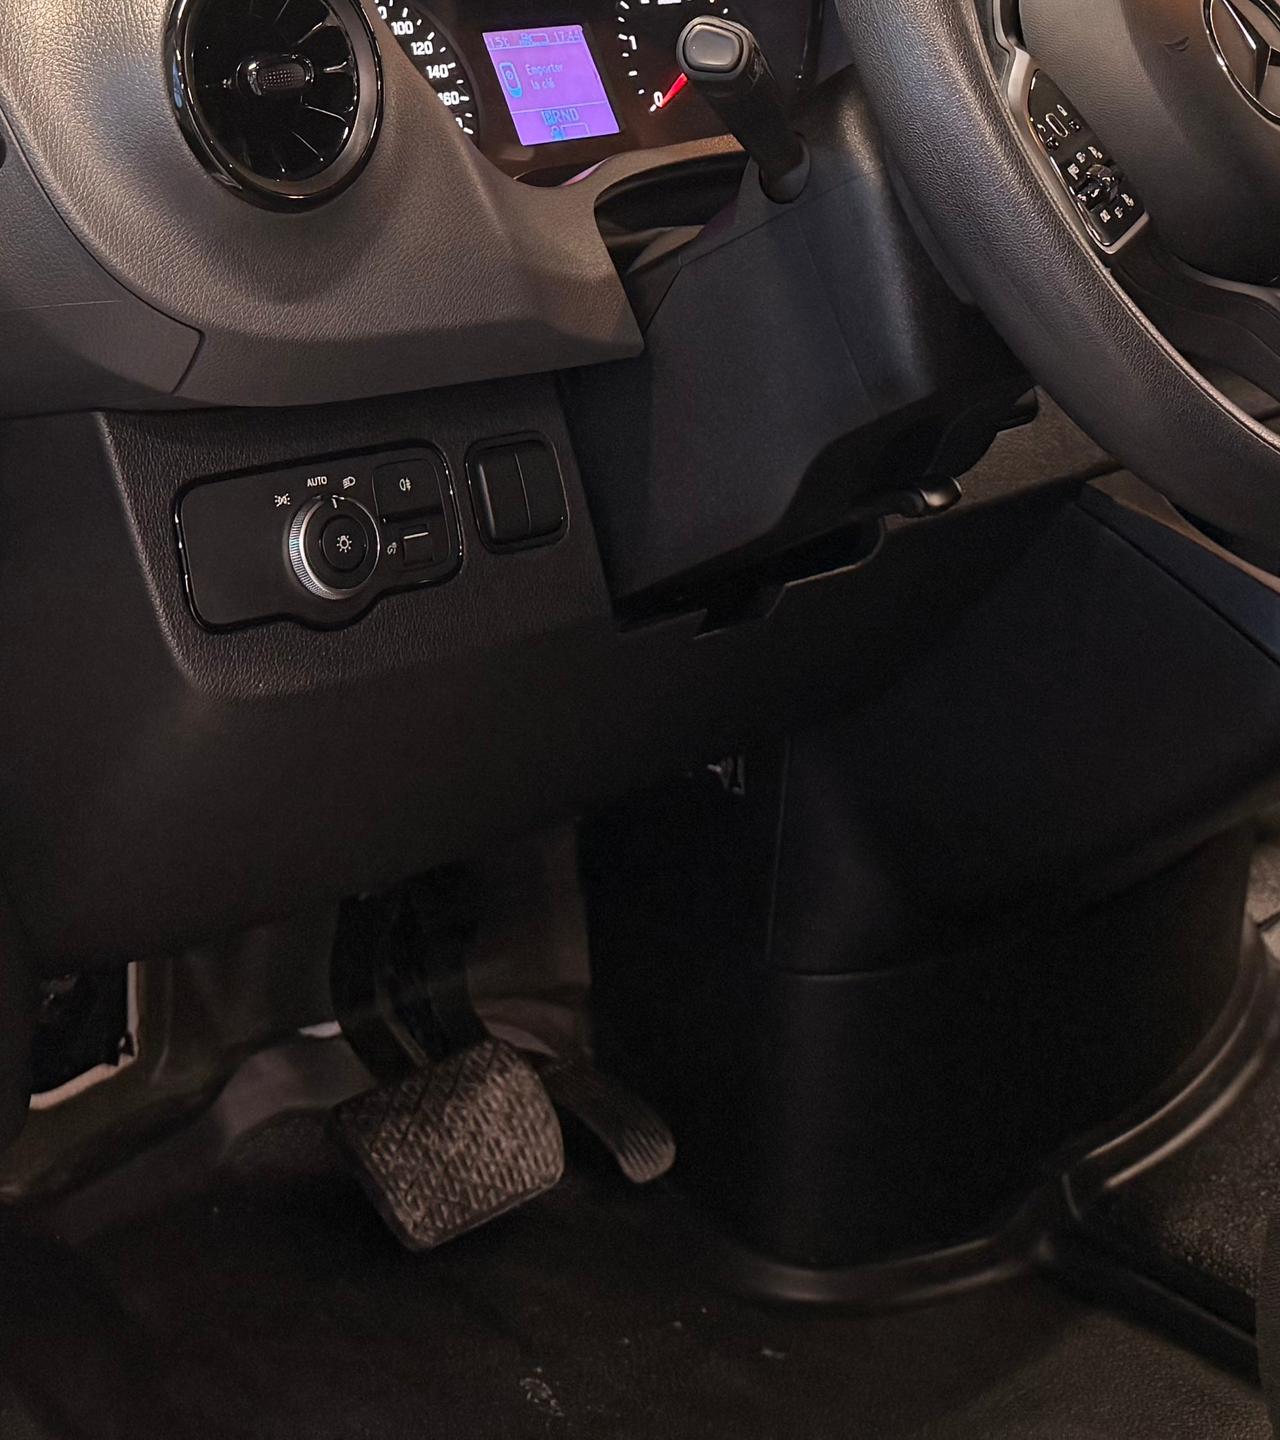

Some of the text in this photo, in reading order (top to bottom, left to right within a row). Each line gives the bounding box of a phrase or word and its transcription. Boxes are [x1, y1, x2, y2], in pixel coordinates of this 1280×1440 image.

[391, 21, 414, 35] 100
[411, 40, 433, 55] 120
[628, 35, 637, 50] 1
[426, 64, 449, 79] 140
[653, 91, 663, 107] 0
[307, 475, 328, 487] AUTO
